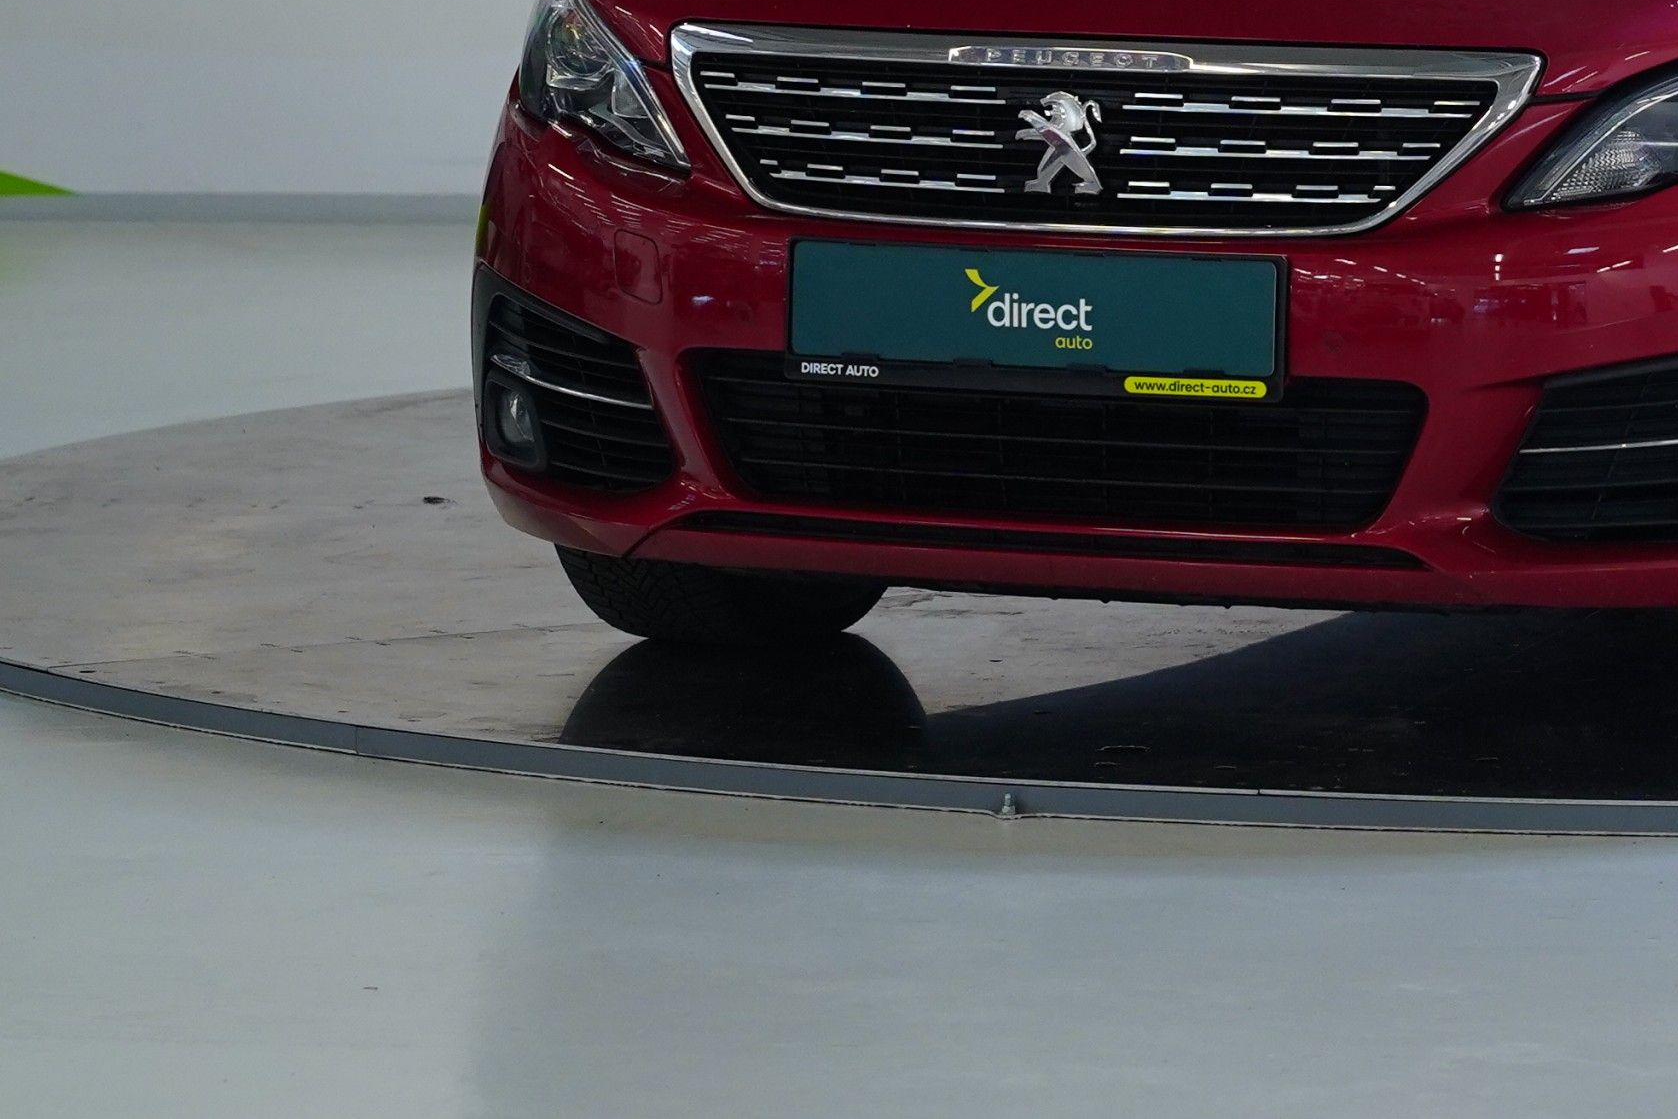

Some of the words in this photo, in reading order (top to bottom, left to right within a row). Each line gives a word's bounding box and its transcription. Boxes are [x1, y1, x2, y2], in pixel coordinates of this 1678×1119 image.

[986, 48, 1160, 69] PEUGEOT
[986, 292, 1093, 331] direct
[1055, 335, 1093, 351] auto
[801, 361, 844, 376] DIRECT
[845, 363, 879, 378] AUTO
[1134, 378, 1257, 397] www.direct-auto.cz
